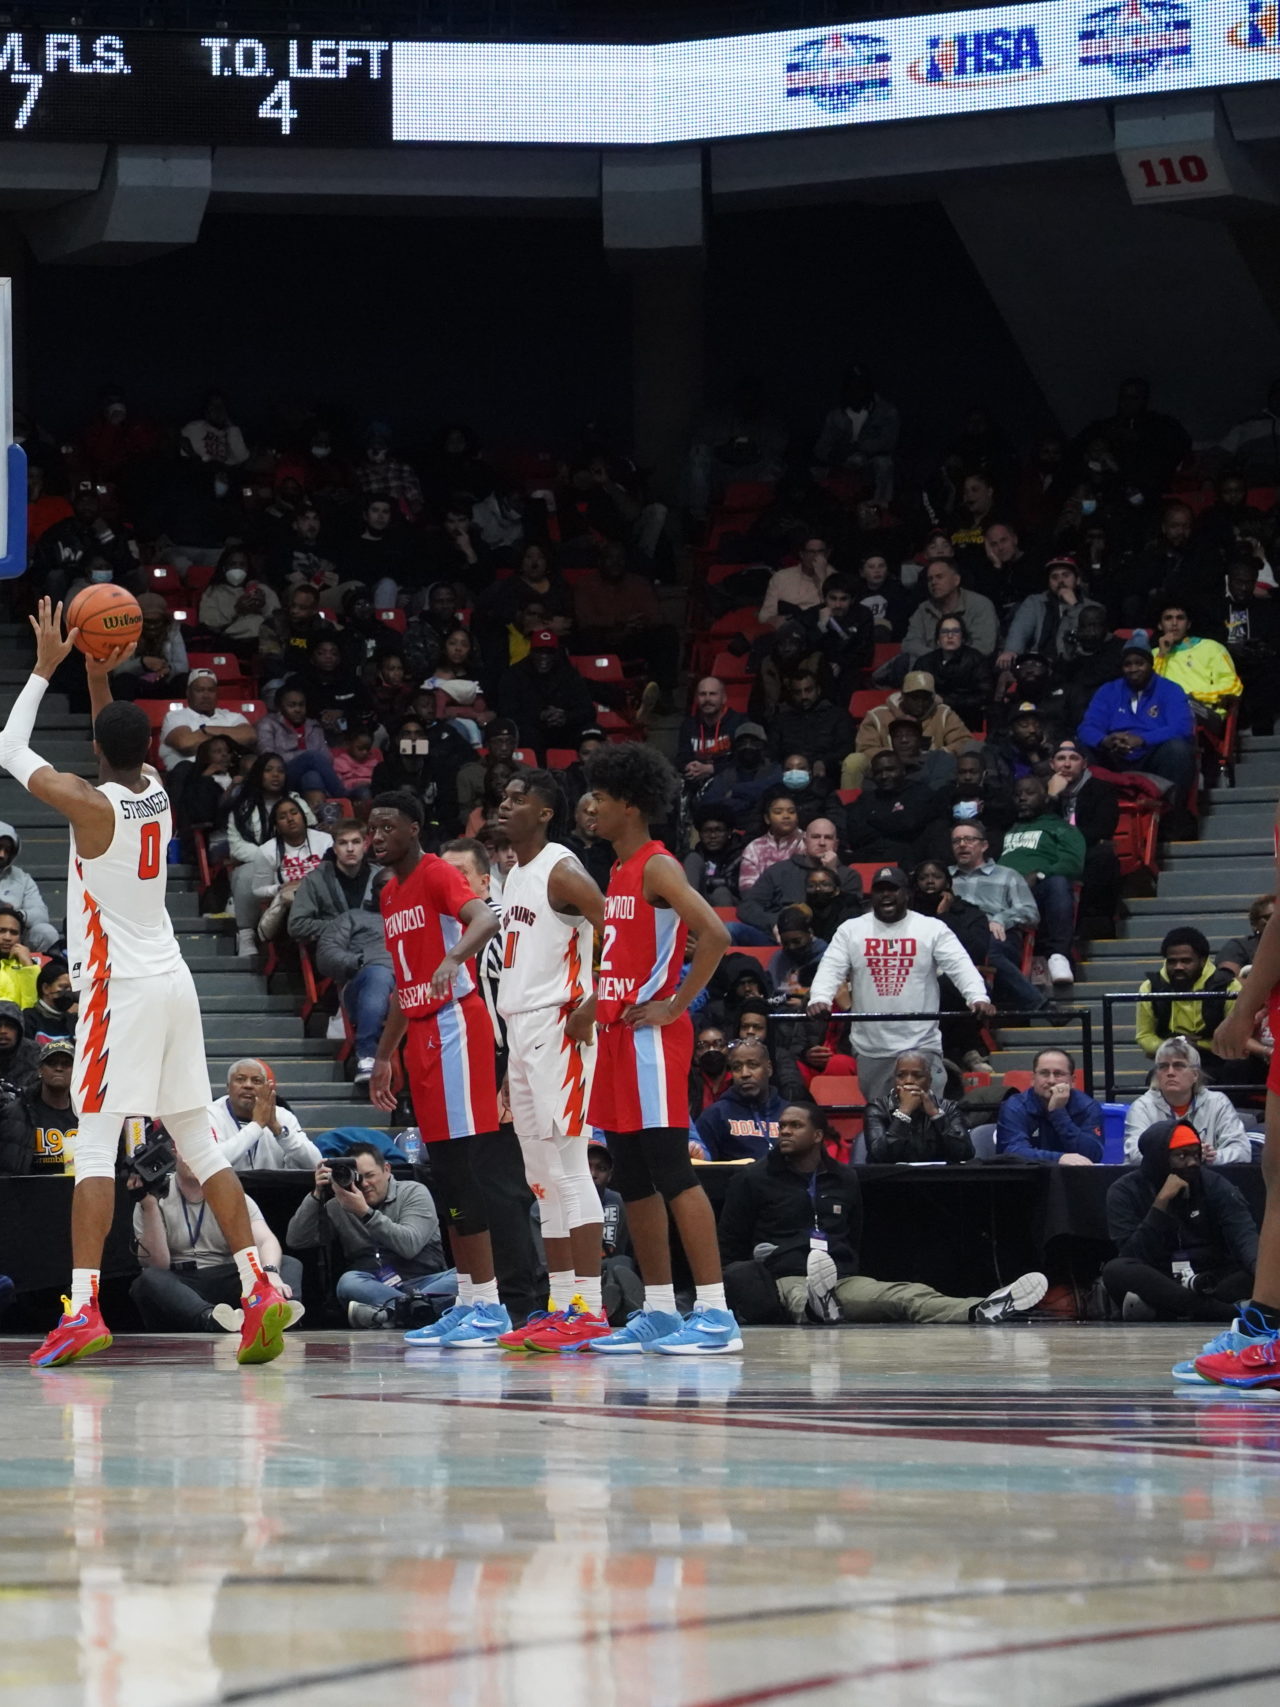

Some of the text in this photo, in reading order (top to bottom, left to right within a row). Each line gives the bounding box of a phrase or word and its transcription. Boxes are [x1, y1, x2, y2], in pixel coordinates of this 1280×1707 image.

[45, 33, 132, 74] FLS.
[288, 39, 390, 79] LEFT
[10, 73, 43, 129] 7
[258, 80, 298, 135] 4
[1138, 155, 1208, 187] 110
[138, 821, 161, 880] 0
[397, 939, 413, 982] 1
[600, 925, 617, 970] 2
[866, 958, 914, 968] RED
[870, 968, 910, 976] RED
